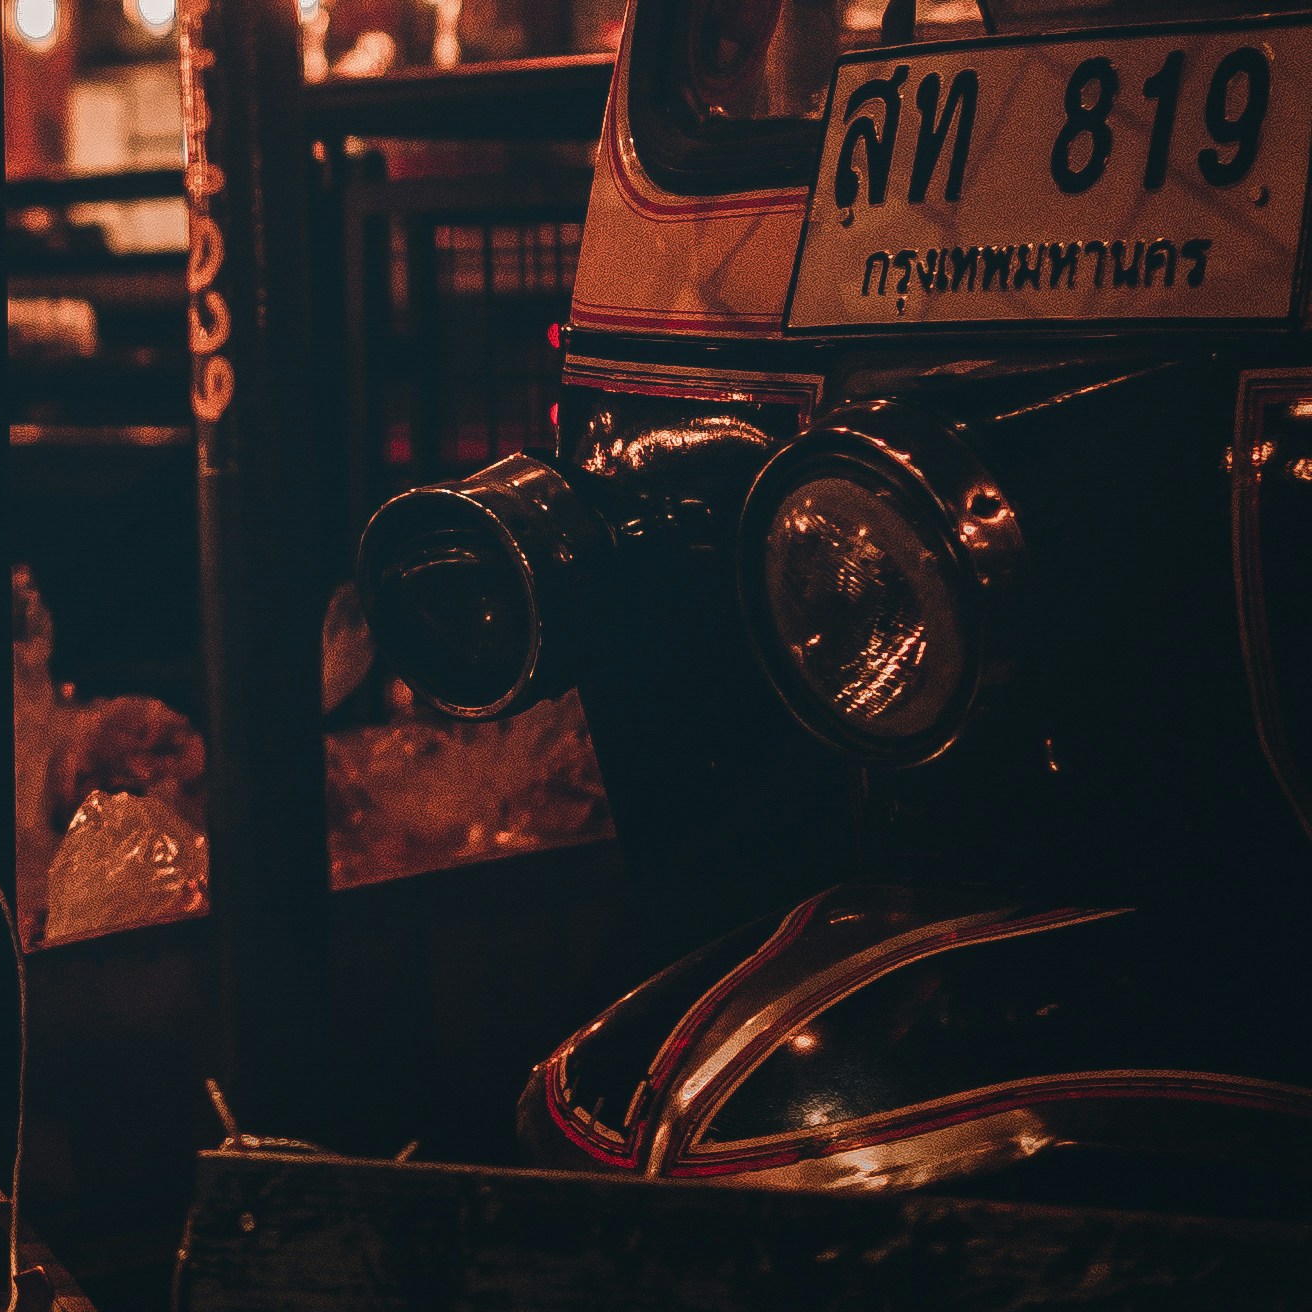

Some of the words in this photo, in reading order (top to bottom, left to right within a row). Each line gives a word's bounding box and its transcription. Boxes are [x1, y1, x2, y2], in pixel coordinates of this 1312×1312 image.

[834, 65, 978, 208] สท
[1051, 47, 1272, 193] 819
[862, 238, 1211, 315] กรุงเทพมหานคร
